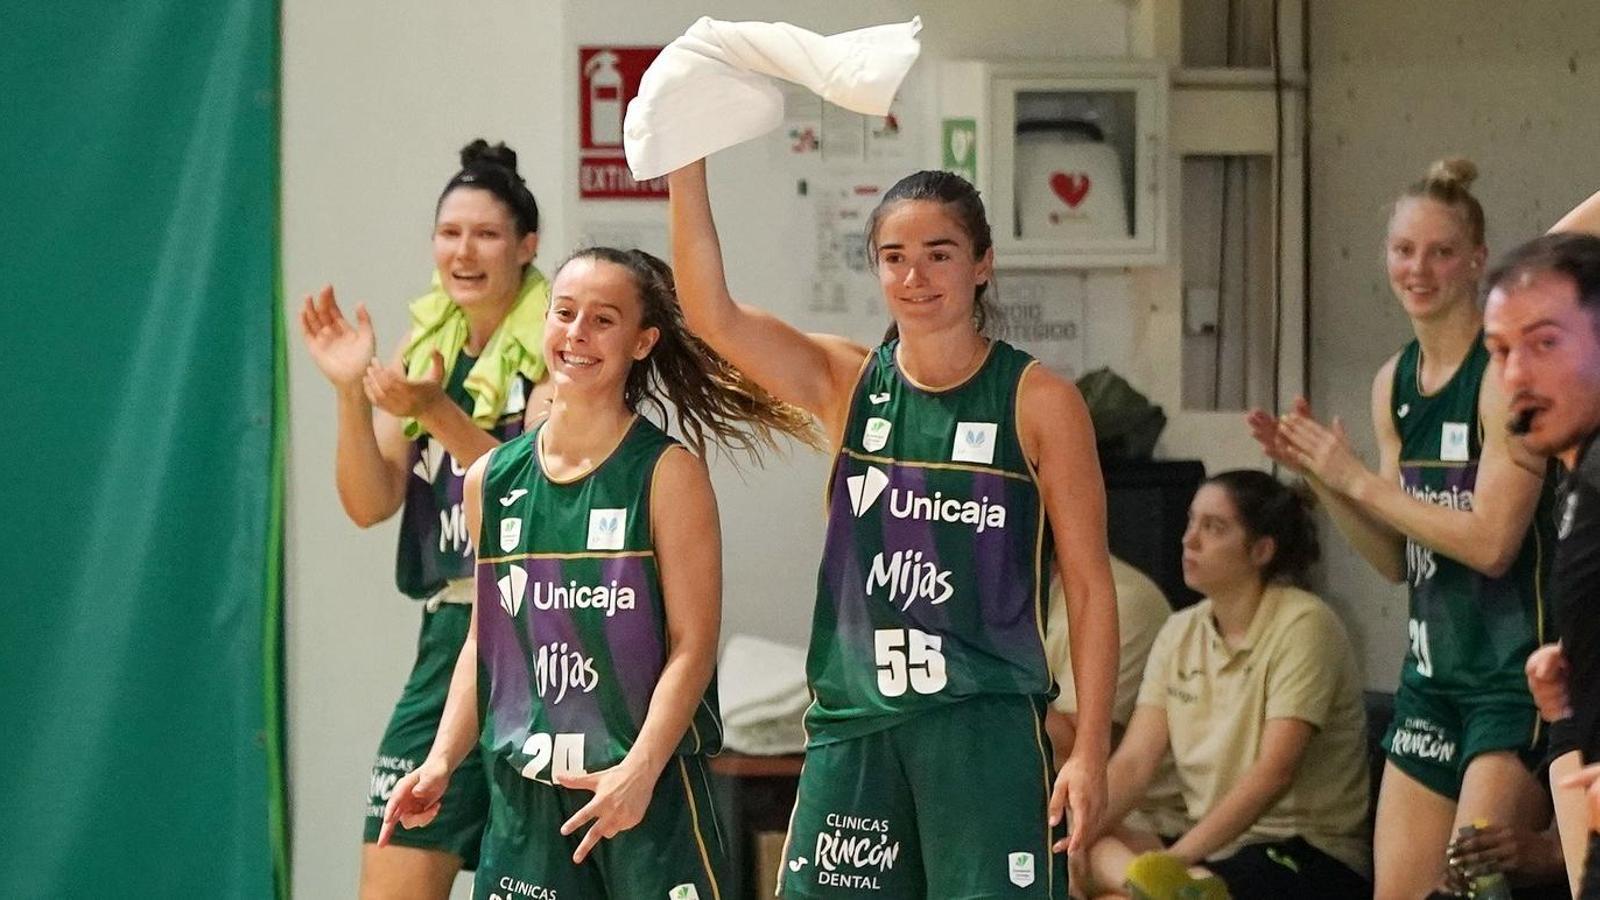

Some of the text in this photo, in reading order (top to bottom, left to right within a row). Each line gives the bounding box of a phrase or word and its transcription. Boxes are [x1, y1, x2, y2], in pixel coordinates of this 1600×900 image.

[889, 488, 1006, 533] Unicaja
[533, 579, 636, 617] Unicaja
[866, 549, 954, 612] Mijas
[874, 628, 947, 697] 55
[826, 813, 889, 832] CLINICAS
[815, 829, 899, 872] RINCÓN
[499, 876, 557, 900] CLINICAS
[818, 871, 881, 889] DENTAL
